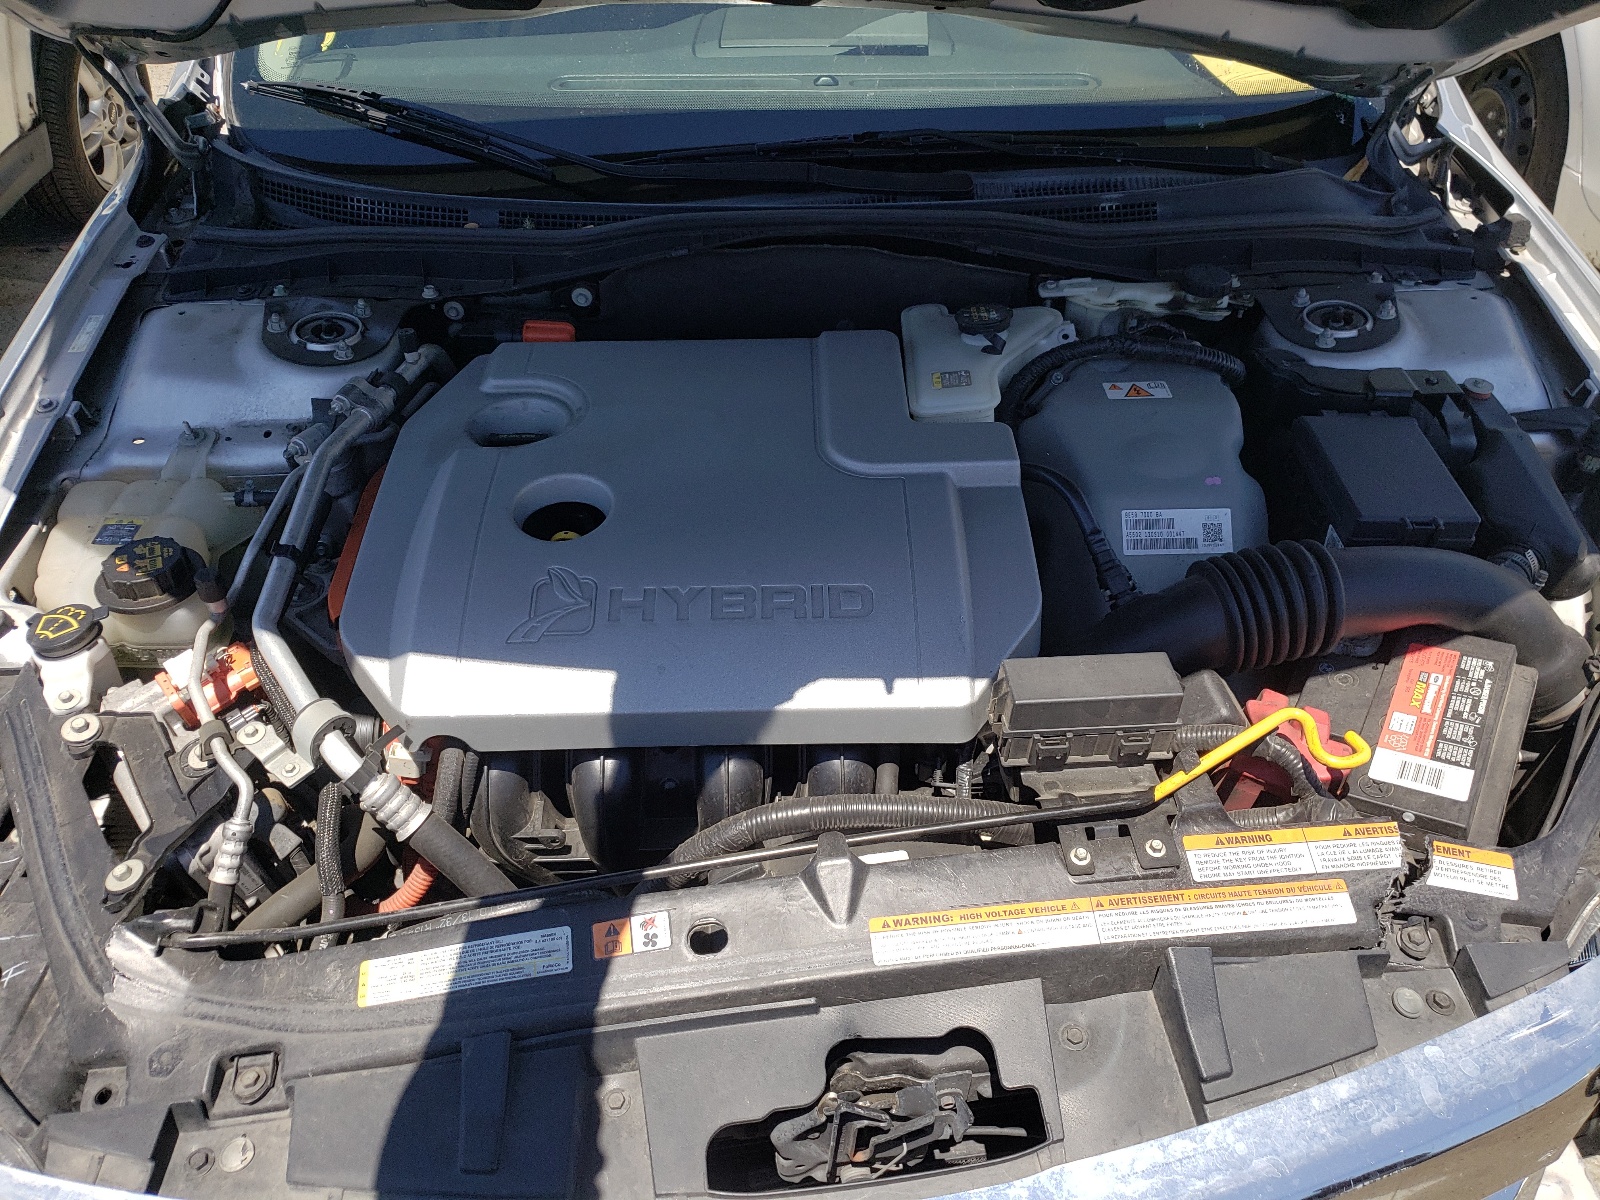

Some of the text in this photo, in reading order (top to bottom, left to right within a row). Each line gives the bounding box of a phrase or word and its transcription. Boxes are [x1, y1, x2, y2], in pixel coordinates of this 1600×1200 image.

[607, 583, 874, 622] HYBRID
[1409, 681, 1427, 709] MAX
[1224, 833, 1273, 845] WARNING
[1108, 893, 1185, 907] AVERTISSEMENT
[1193, 892, 1227, 901] CIRCUITS
[1228, 890, 1252, 898] HAUTE
[1254, 888, 1285, 896] TENSION
[893, 904, 1067, 928] WARNING: HIGH VOLTAGE VEHICLE
